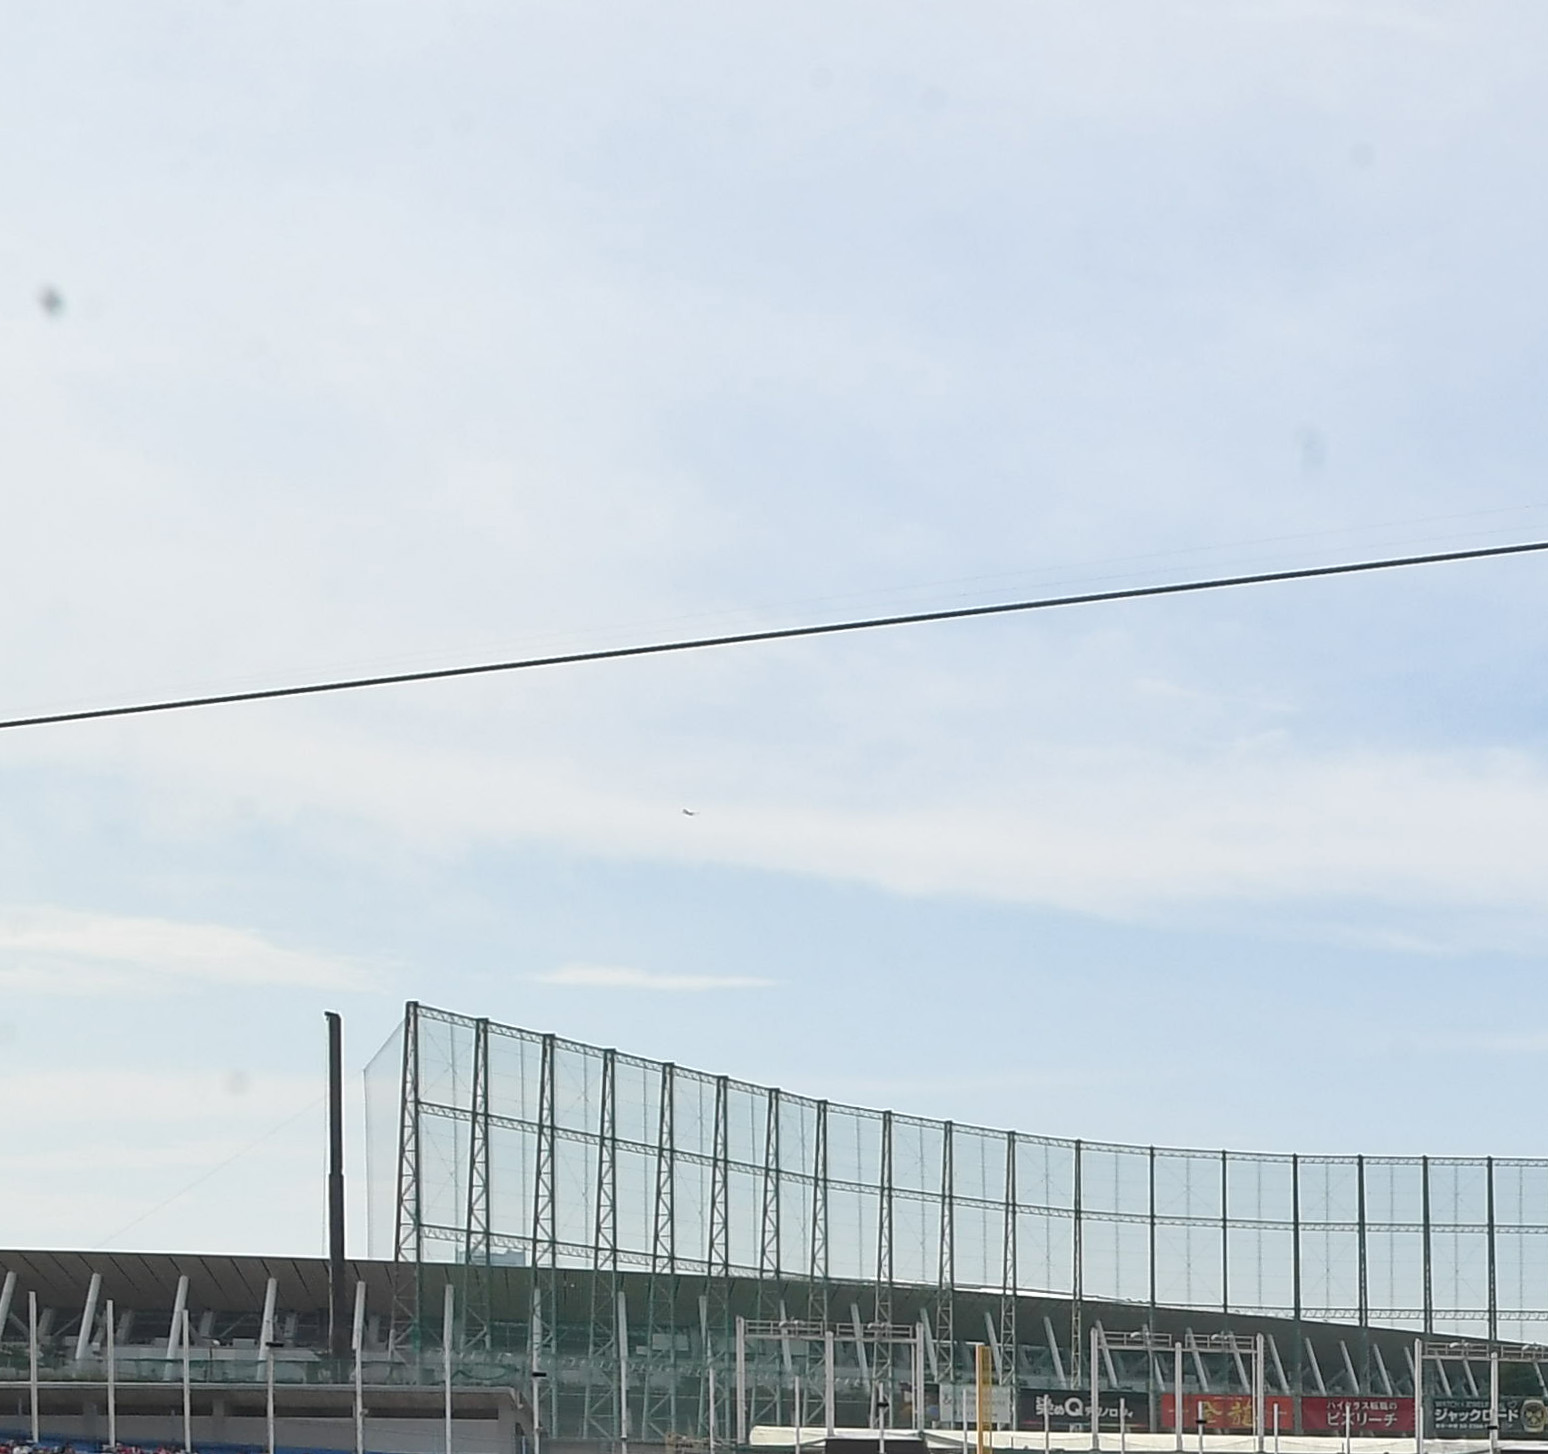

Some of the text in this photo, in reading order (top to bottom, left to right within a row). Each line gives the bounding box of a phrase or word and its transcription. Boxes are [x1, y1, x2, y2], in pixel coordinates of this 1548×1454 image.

[1326, 1411, 1398, 1426] ビズリーチ
[1434, 1408, 1519, 1422] ジャックロード
